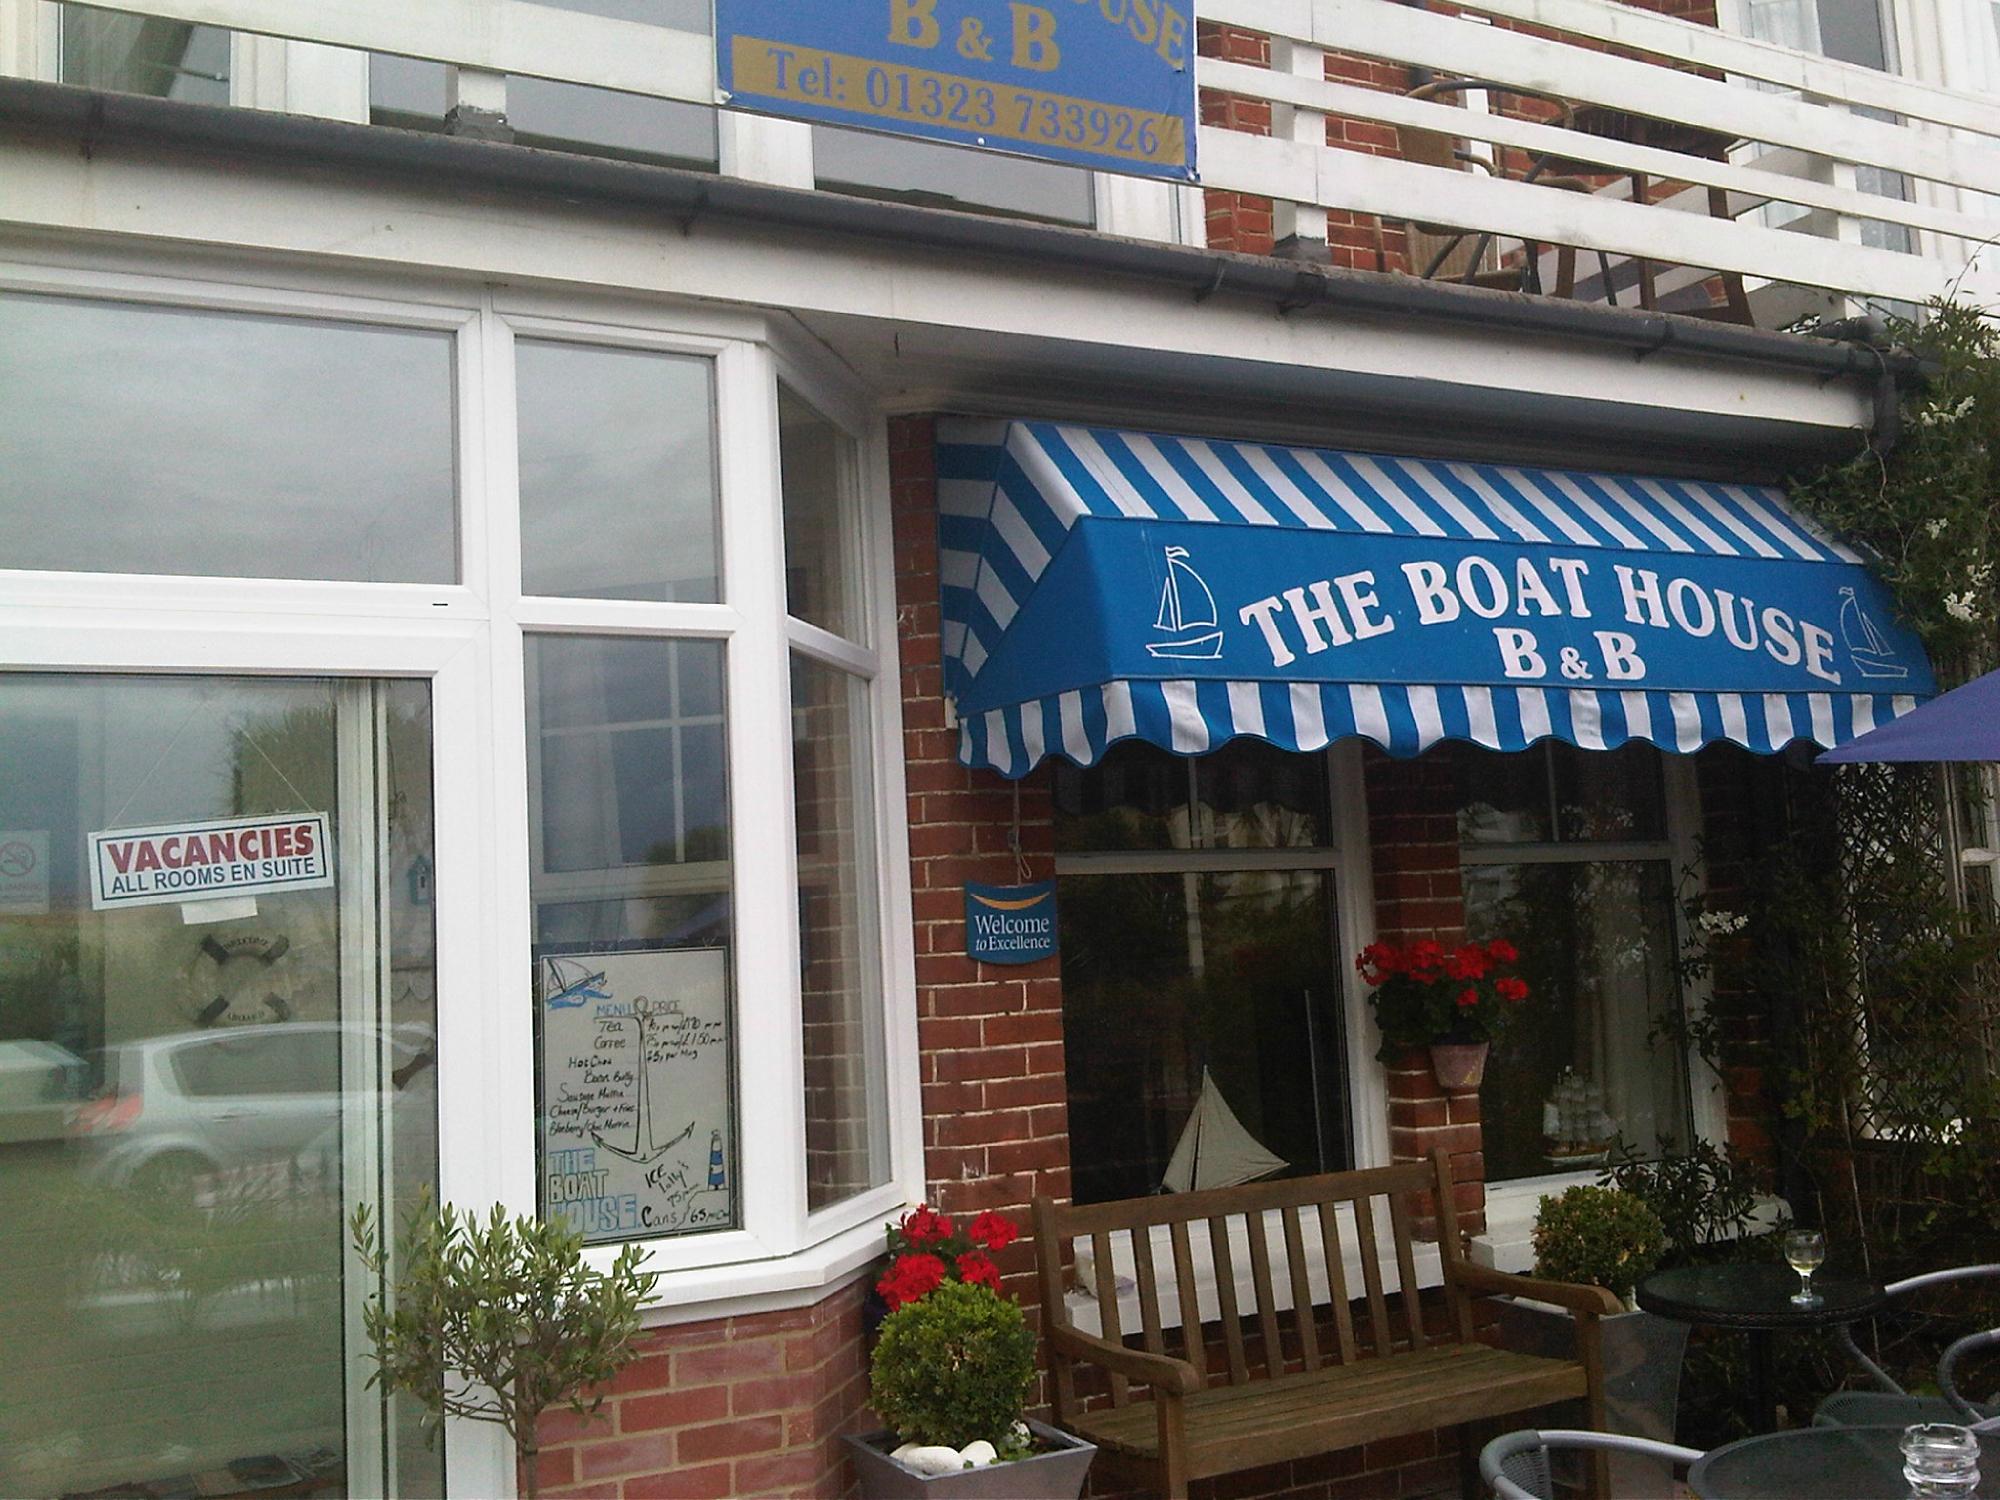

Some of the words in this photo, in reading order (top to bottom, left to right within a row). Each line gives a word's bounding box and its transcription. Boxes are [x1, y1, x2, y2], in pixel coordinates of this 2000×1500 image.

[889, 0, 939, 49] B
[956, 17, 993, 62] &
[1010, 3, 1062, 73] B
[767, 47, 846, 100] Tel:
[866, 66, 997, 128] 01323
[1012, 95, 1159, 156] 733926
[1238, 569, 1395, 668] THE
[1400, 555, 1592, 626] BOAT
[1612, 564, 1842, 686] HOUSE
[1492, 627, 1547, 679] B
[1559, 646, 1594, 680] &
[1593, 630, 1647, 681] B
[107, 825, 315, 875] VACANCIES
[112, 876, 149, 895] ALL
[155, 866, 226, 888] ROOMS
[231, 864, 256, 882] EN
[262, 857, 316, 878] SUITE
[974, 914, 1051, 935] Welcome
[975, 938, 988, 951] to
[988, 935, 1051, 951] Excellence
[549, 1147, 595, 1174] THE
[549, 1168, 610, 1204] BOAT
[641, 1206, 678, 1228] Cans
